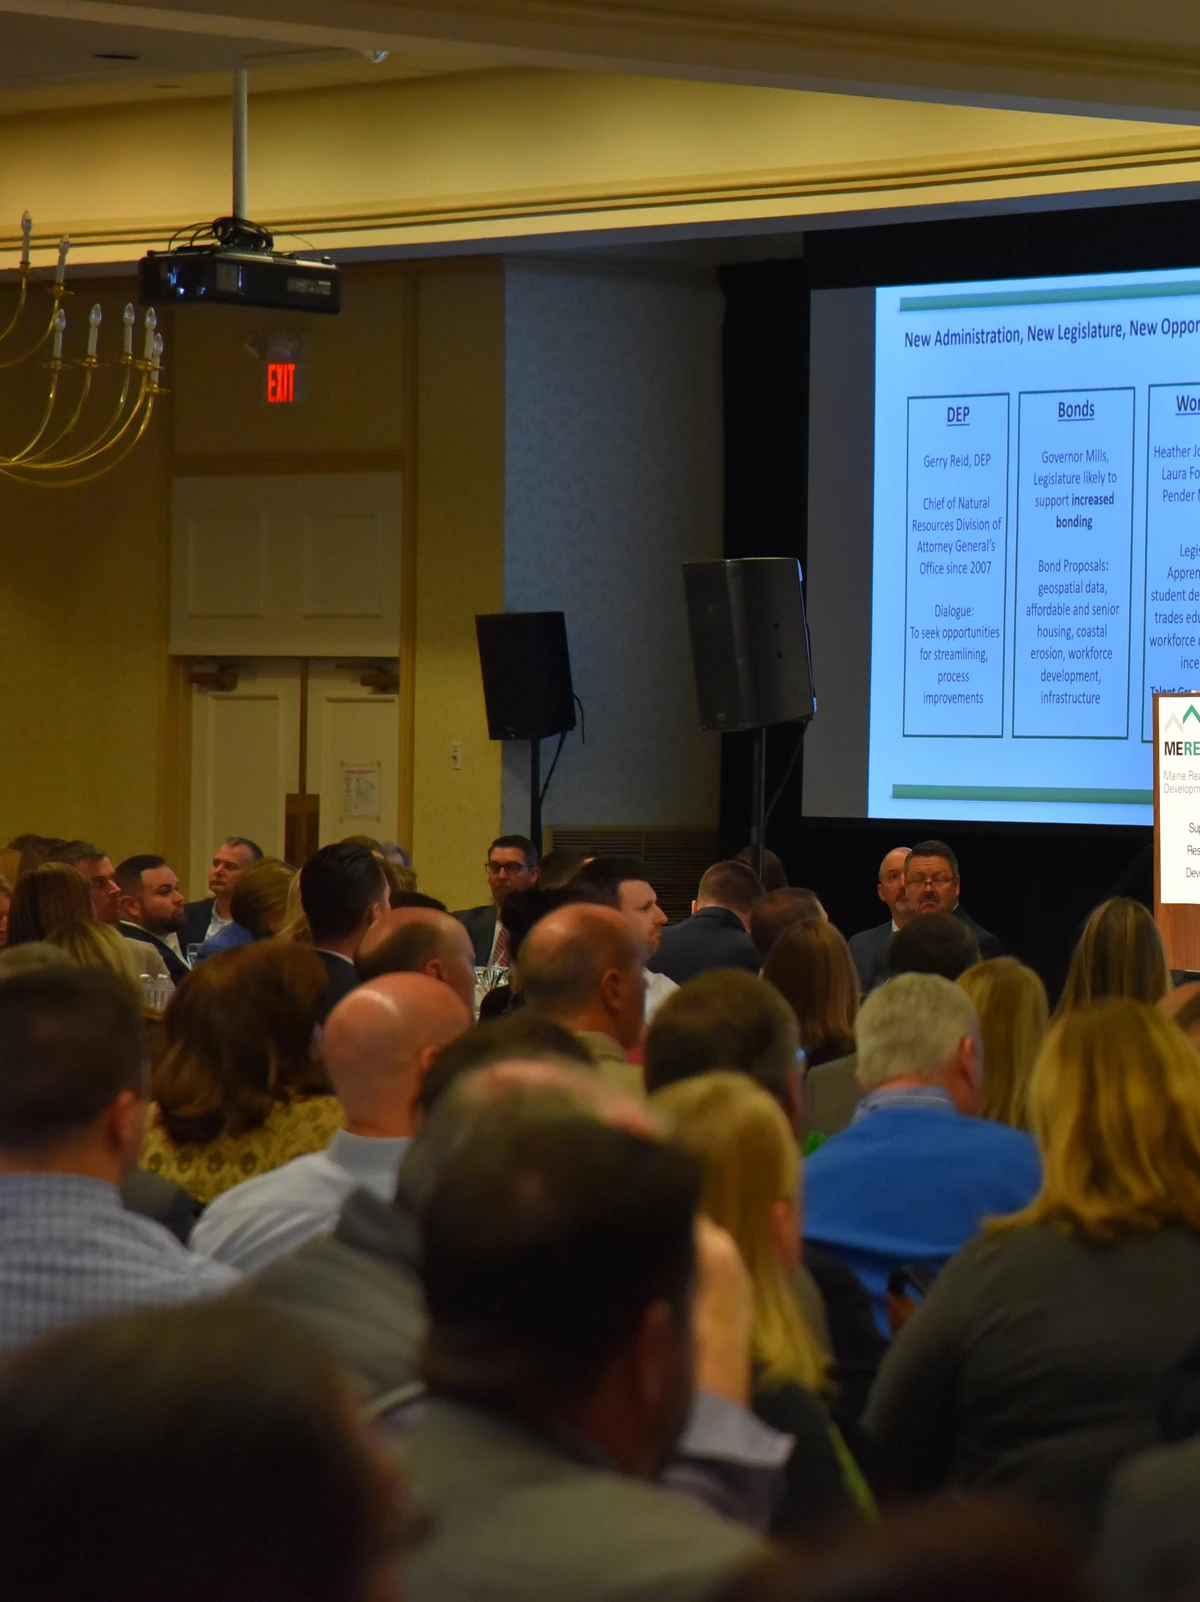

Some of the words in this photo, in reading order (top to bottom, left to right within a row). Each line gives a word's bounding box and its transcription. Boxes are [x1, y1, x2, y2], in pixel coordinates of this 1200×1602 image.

[905, 332, 931, 347] New
[934, 326, 1024, 346] Administration,
[1027, 325, 1054, 341] New
[1057, 321, 1126, 343] Legislature,
[1129, 319, 1157, 336] New
[268, 363, 296, 402] EXIT
[947, 406, 970, 423] DEP
[1058, 399, 1095, 418] Bonds
[1041, 450, 1083, 463] Governor
[1085, 449, 1109, 464] Mills,
[1154, 445, 1191, 458] Heather
[924, 455, 948, 470] Gerry
[950, 454, 971, 469] Reid,
[974, 453, 991, 467] DEP
[1033, 472, 1081, 488] Legislature
[1083, 471, 1106, 486] likely
[1108, 472, 1117, 483] to
[1162, 467, 1187, 480] Laura
[923, 497, 945, 510] Chief
[947, 496, 956, 510] of
[958, 496, 990, 509] Natural
[1035, 495, 1069, 509] support
[1071, 492, 1115, 506] increased
[1162, 489, 1195, 502] Pender
[912, 519, 954, 532] Resources
[956, 518, 990, 531] Division
[992, 517, 1002, 530] of
[1056, 514, 1093, 530] bonding
[917, 541, 953, 555] Attorney
[919, 562, 944, 575] Office
[946, 561, 968, 574] since
[970, 561, 992, 574] 2007
[1038, 559, 1060, 572] Bond
[1063, 559, 1109, 575] Proposals:
[1038, 581, 1083, 597] geospatial
[1085, 580, 1108, 595] data,
[1151, 588, 1186, 602] student
[934, 604, 974, 620] Dialogue:
[1026, 602, 1070, 616] affordable
[1073, 602, 1090, 616] and
[1092, 602, 1120, 616] senior
[1155, 610, 1183, 624] trades
[910, 626, 919, 639] To
[922, 626, 940, 639] seek
[942, 625, 1000, 642] opportunities
[1037, 625, 1074, 641] housing,
[1076, 624, 1107, 638] coastal
[1149, 632, 1195, 647] workforce
[920, 647, 932, 660] for
[934, 647, 988, 663] streamlining,
[1031, 646, 1066, 662] erosion,
[1068, 646, 1113, 660] workforce
[938, 672, 970, 685] process
[1040, 668, 1102, 684] development,
[923, 691, 984, 707] improvements
[1040, 690, 1100, 704] infrastructure
[1164, 770, 1186, 781] Maine
